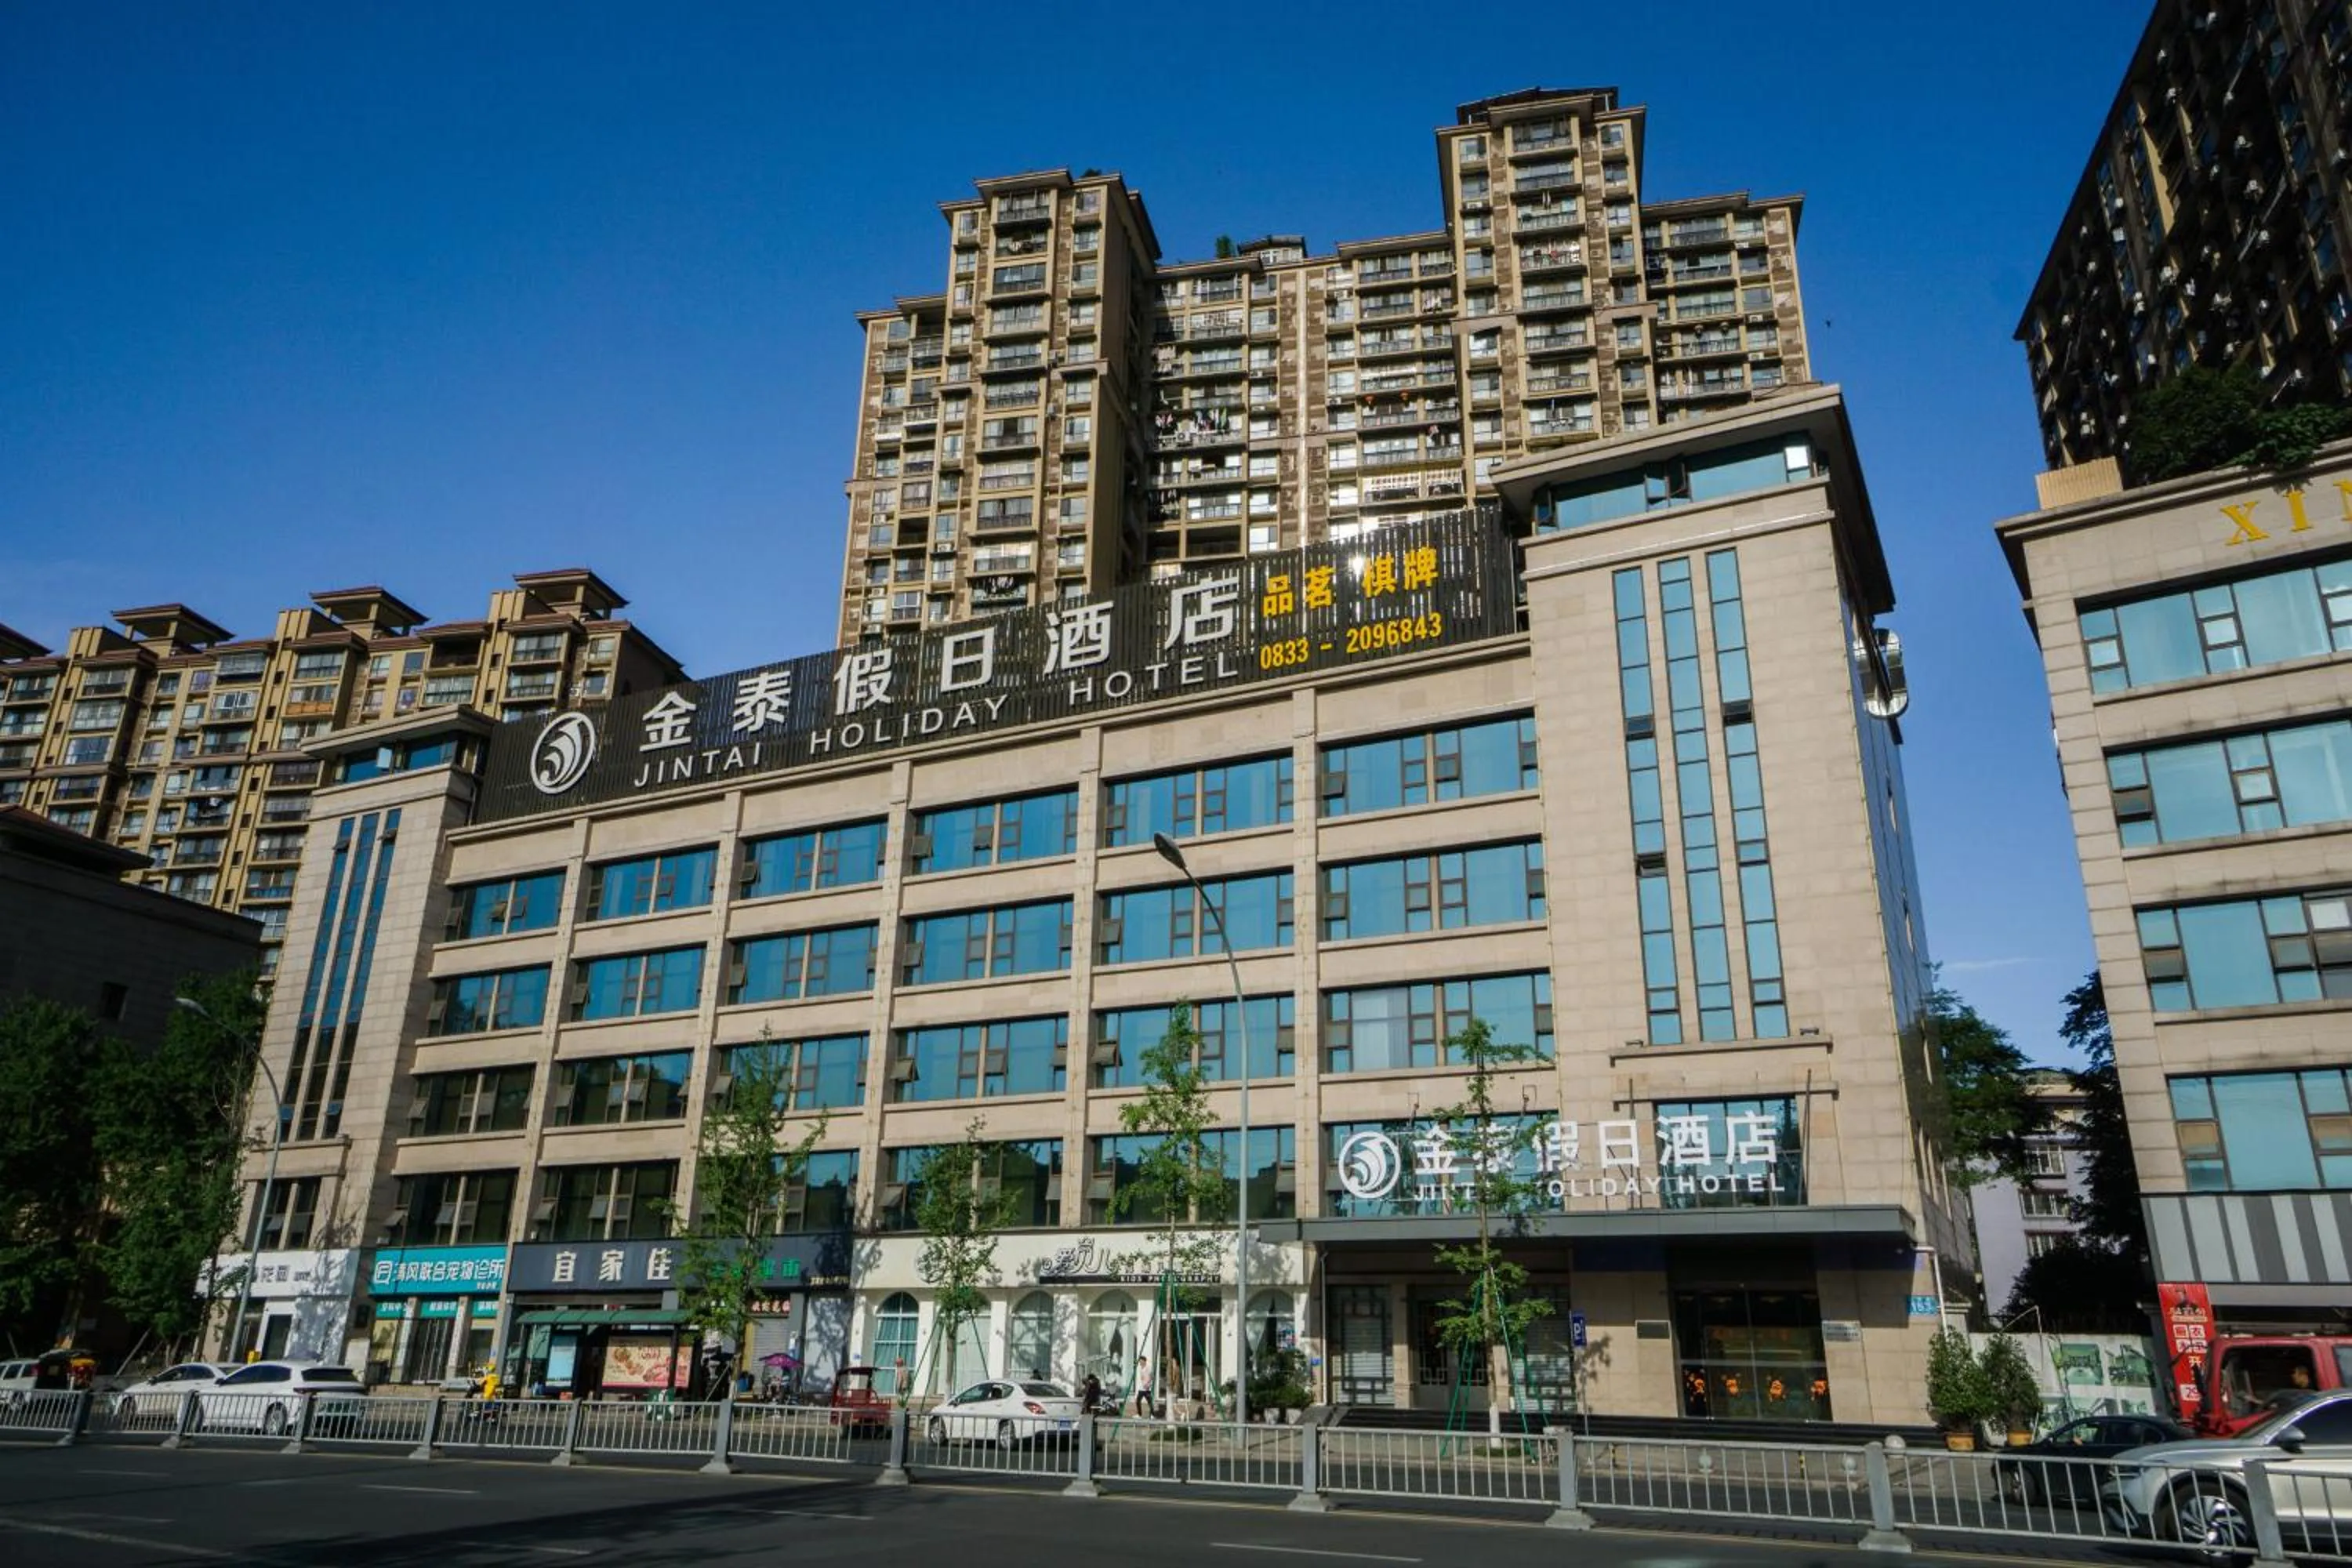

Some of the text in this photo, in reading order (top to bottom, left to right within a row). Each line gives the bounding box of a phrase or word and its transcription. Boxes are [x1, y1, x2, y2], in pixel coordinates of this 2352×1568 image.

[1263, 545, 1439, 618] 品茗 棋牌
[639, 575, 1240, 753] 金泰假日酒店
[1259, 636, 1309, 670] 0833
[1345, 612, 1442, 654] 2096843
[633, 651, 1240, 788] JINTAI HOLIDAY HOTEL
[1533, 1177, 1662, 1200] OLIDAY
[1677, 1172, 1785, 1194] HOTEL
[551, 1247, 673, 1283] 宜家佳
